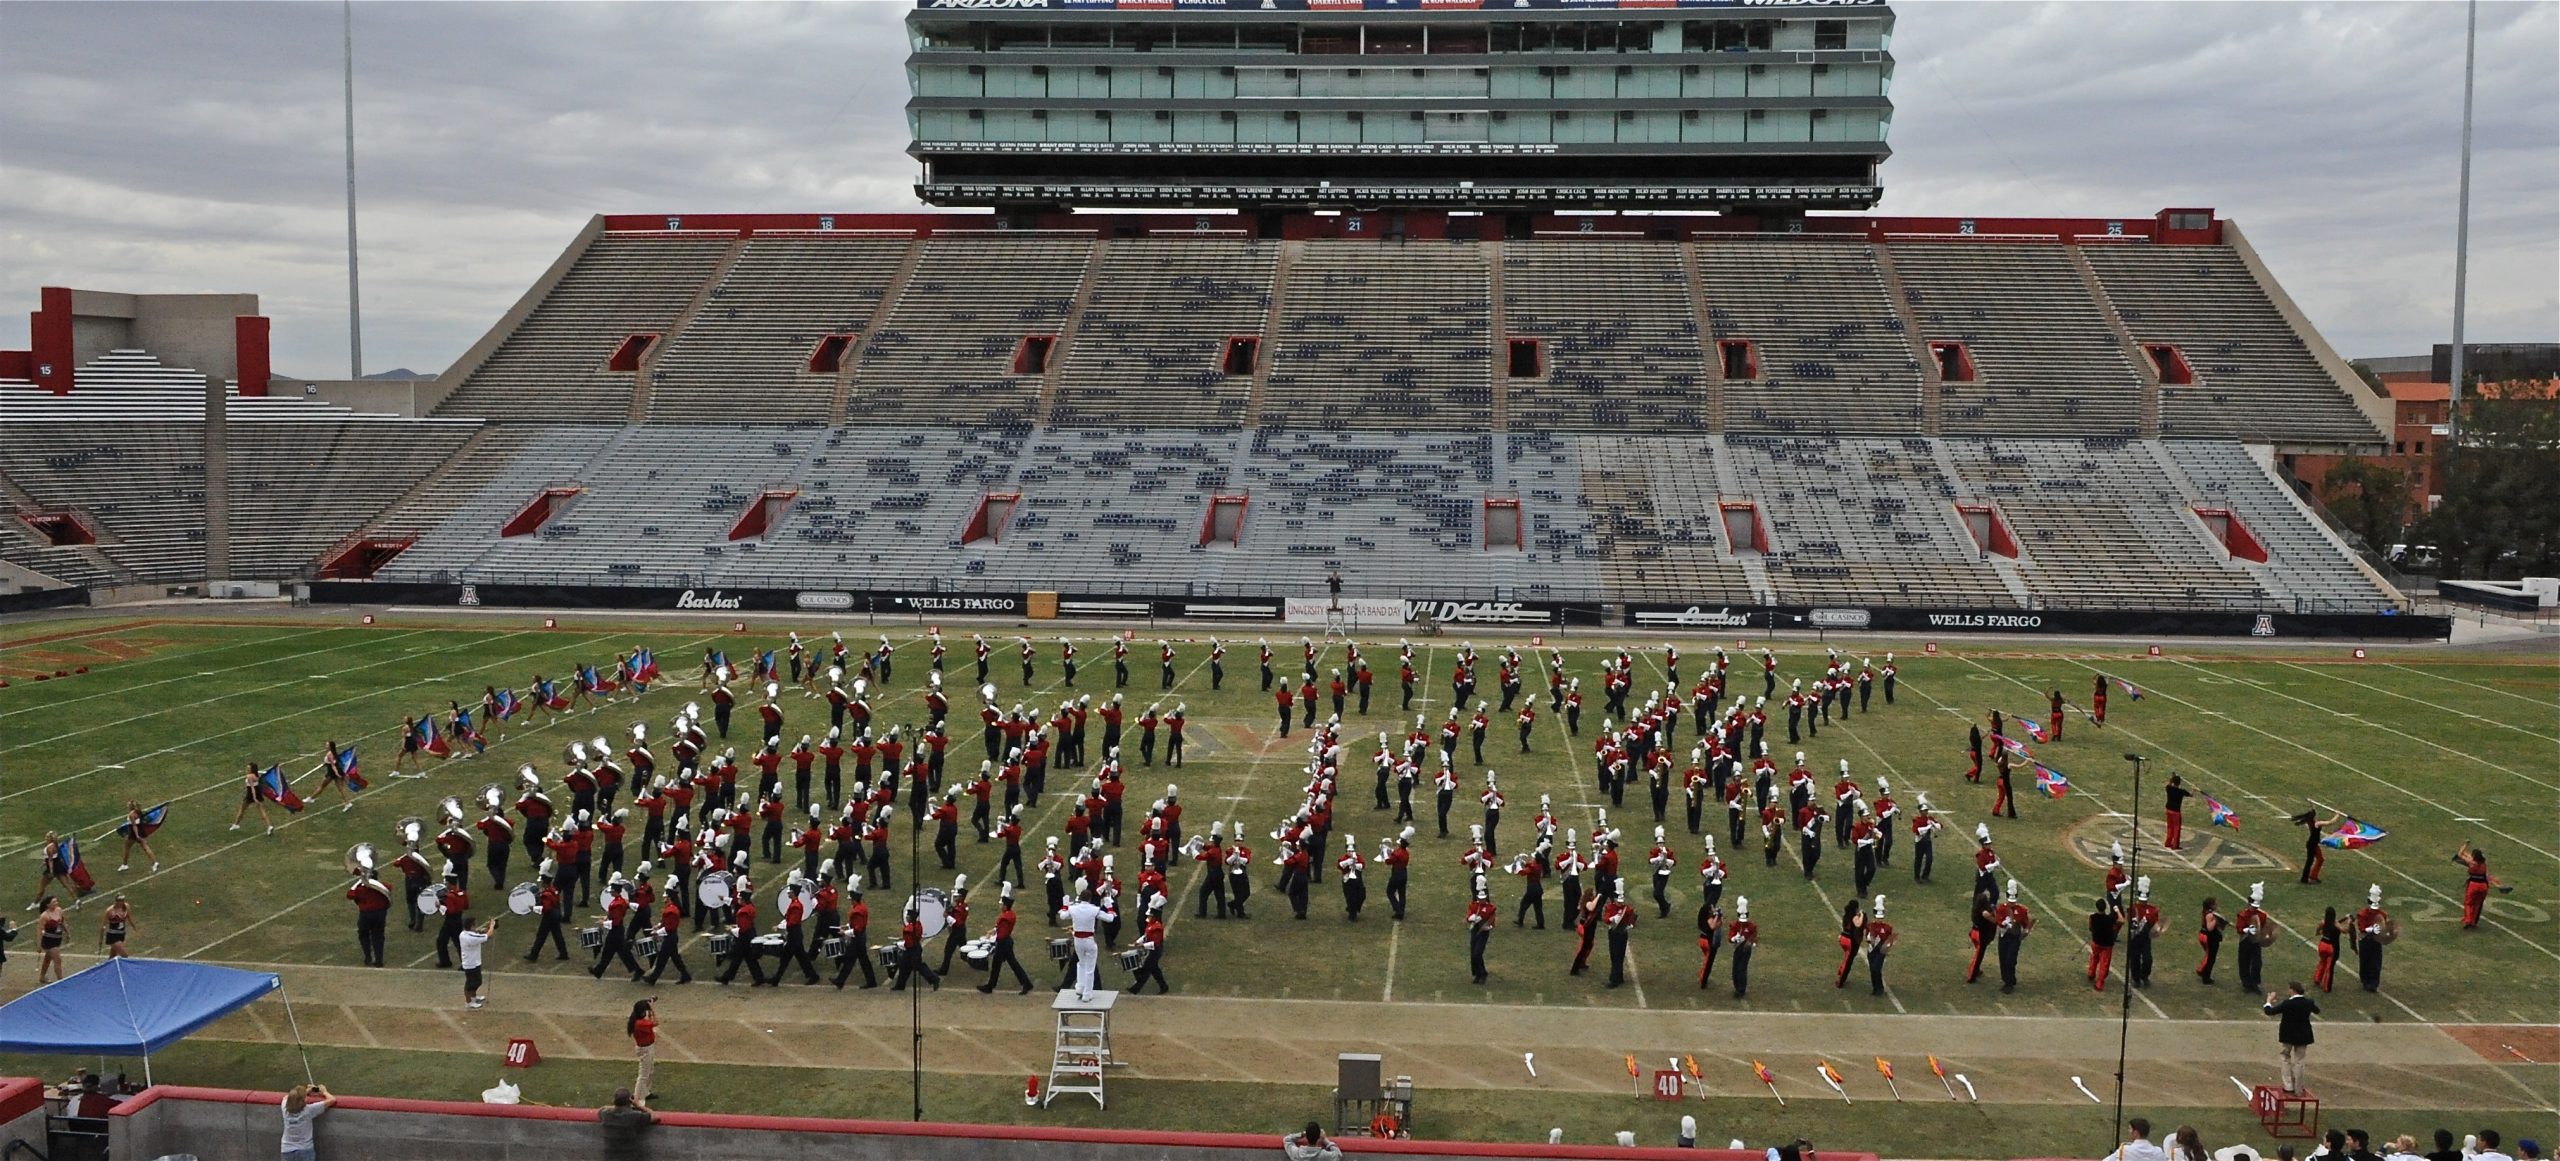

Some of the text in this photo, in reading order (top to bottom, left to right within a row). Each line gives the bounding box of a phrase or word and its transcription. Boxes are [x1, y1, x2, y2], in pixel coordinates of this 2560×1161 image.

[668, 222, 680, 231] 17
[820, 221, 832, 230] 18
[996, 221, 1008, 230] 19
[1196, 221, 1210, 230] 20
[1348, 221, 1360, 230] 21
[1580, 222, 1594, 232] 22
[1788, 224, 1802, 233] 23
[1960, 224, 1974, 234] 24
[2108, 226, 2122, 236] 25
[40, 366, 51, 375] 15
[306, 384, 317, 394] 16
[676, 590, 742, 608] Bashas'
[908, 598, 1014, 610] WELLS FARGO
[1288, 606, 1324, 615] UNIVERSITY
[1367, 606, 1386, 616] BAND
[1388, 606, 1401, 616] DAY
[1928, 614, 2041, 627] WELLS FARGO
[508, 1042, 527, 1063] 40
[1658, 1075, 1678, 1096] 40
